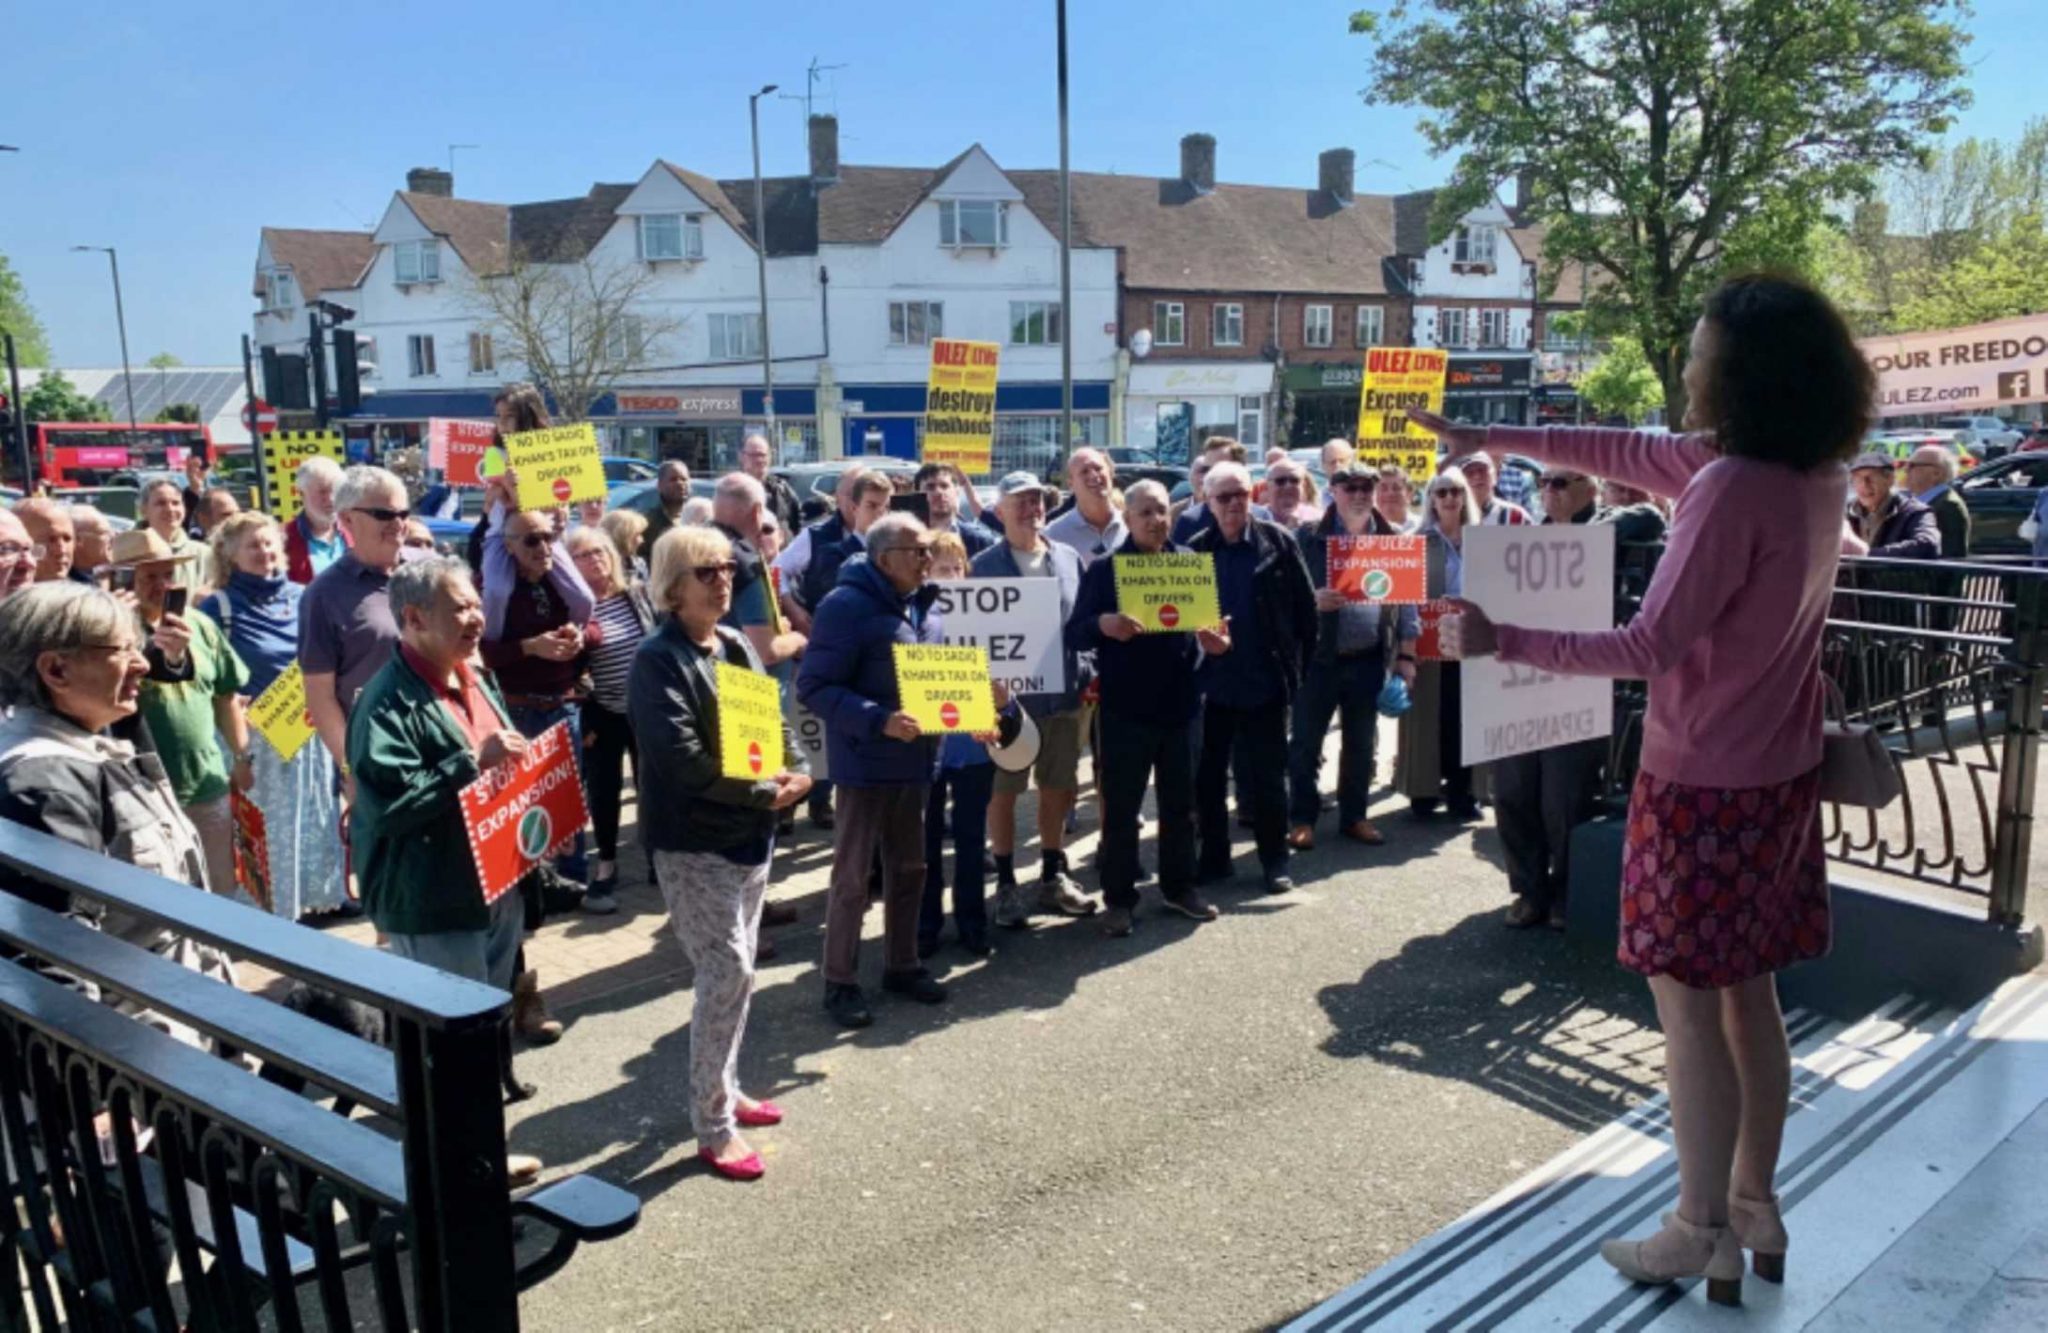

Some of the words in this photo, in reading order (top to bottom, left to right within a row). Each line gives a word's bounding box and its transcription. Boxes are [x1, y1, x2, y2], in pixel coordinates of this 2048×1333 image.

[934, 341, 969, 366] ULEZ
[1368, 350, 1412, 373] ULEZ
[1872, 351, 1931, 372] OUR
[1939, 336, 2048, 366] FREEDO
[619, 396, 679, 412] TESCO
[681, 397, 738, 414] express
[928, 386, 995, 415] destroy
[1365, 389, 1429, 410] Excuse
[1882, 385, 1980, 405] ULEZ.com
[1382, 414, 1408, 434] for
[516, 435, 534, 448] NO
[535, 432, 551, 445] TO
[551, 428, 586, 442] SADIQ
[1358, 436, 1436, 451] surveillance
[286, 443, 321, 454] NO
[514, 449, 556, 467] KHAN'S
[557, 447, 578, 459] TAX
[578, 444, 596, 457] ON
[536, 464, 583, 482] DRIVERS
[1338, 537, 1375, 551] STOP
[1381, 537, 1415, 551] ULEZ
[1125, 557, 1145, 569] NO
[1147, 557, 1165, 569] TO
[1166, 556, 1203, 570] SADIQ
[1121, 575, 1167, 586] KHAN'S
[1170, 575, 1192, 586] TAX
[1193, 575, 1212, 586] ON
[937, 586, 1022, 614] STOP
[1143, 593, 1195, 605] DRIVERS
[906, 649, 925, 662] NO
[927, 649, 943, 662] TO
[943, 649, 978, 665] SADIQ
[902, 669, 945, 682] KHAN'S
[946, 669, 968, 682] TAX
[970, 670, 988, 682] ON
[923, 689, 973, 701] DRIVERS
[474, 759, 518, 806] STOP
[477, 761, 574, 842] EXPANSION!
